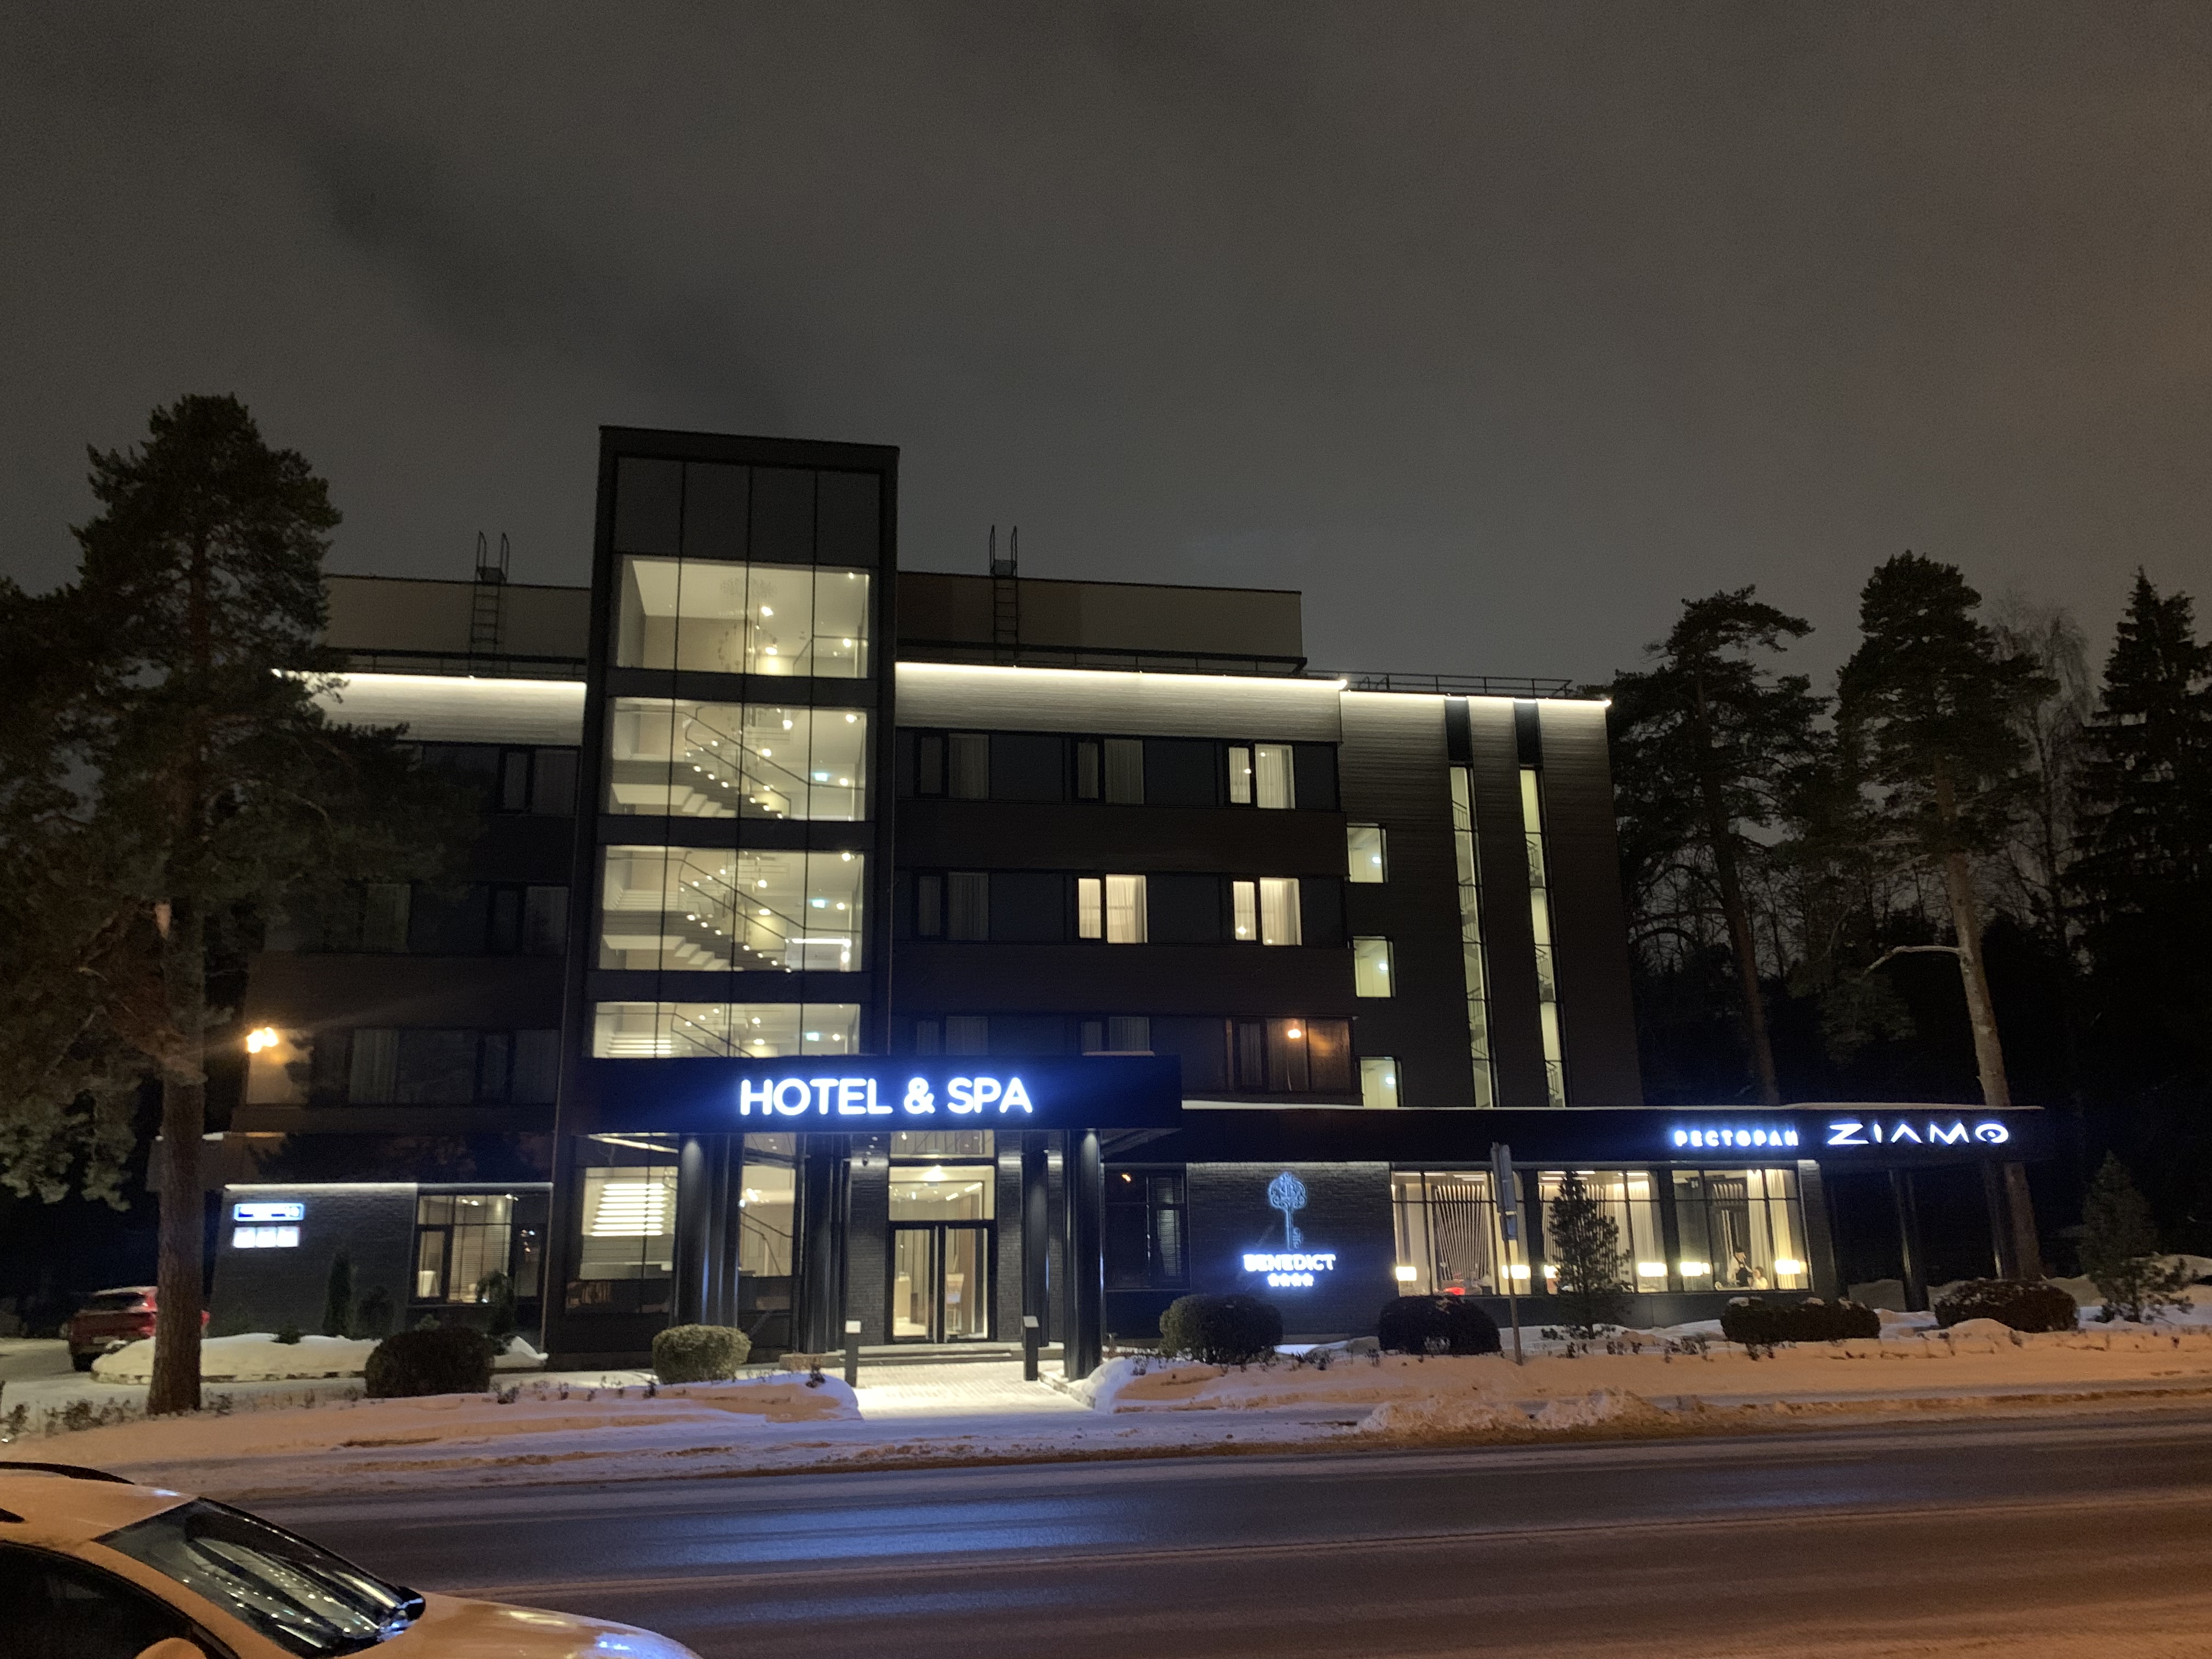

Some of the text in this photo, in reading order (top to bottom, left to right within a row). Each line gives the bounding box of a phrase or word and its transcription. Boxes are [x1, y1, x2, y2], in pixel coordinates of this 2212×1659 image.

[740, 1077, 1033, 1116] HOTEL & SPA
[1673, 1128, 1799, 1147] РЕСТОРАН
[1827, 1122, 2009, 1145] ZIAMO
[1243, 1254, 1336, 1272] BENEDICT
